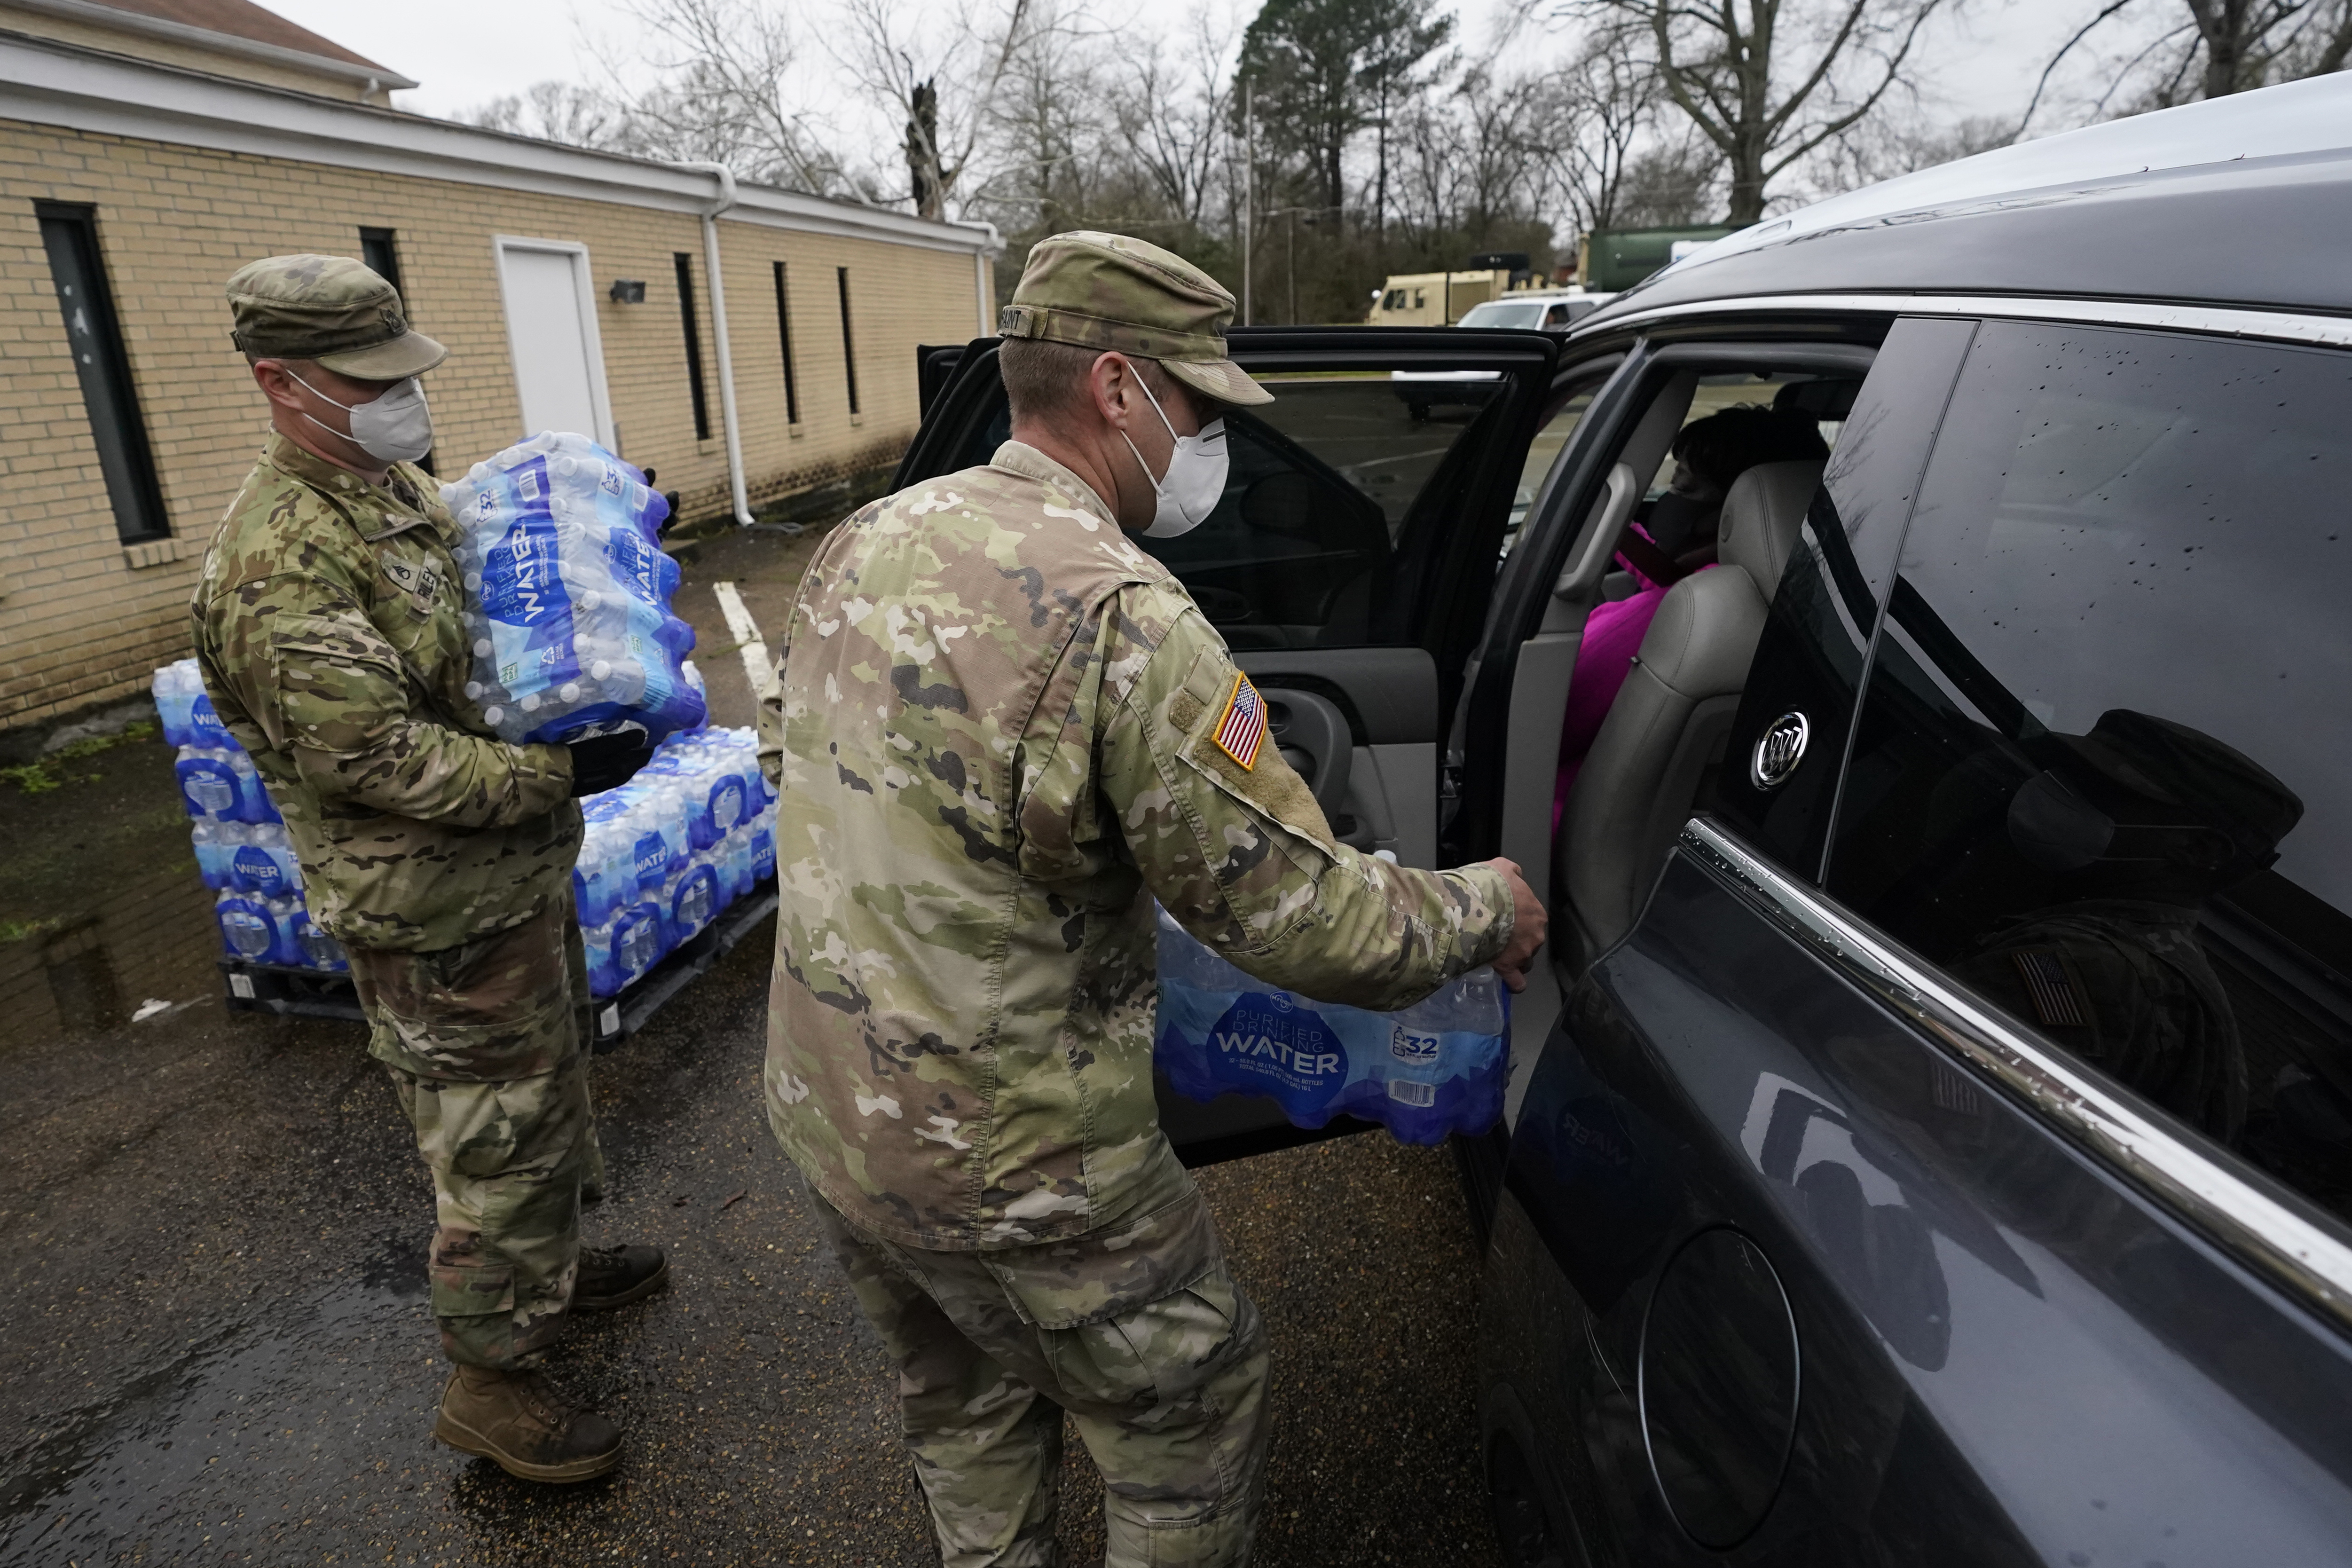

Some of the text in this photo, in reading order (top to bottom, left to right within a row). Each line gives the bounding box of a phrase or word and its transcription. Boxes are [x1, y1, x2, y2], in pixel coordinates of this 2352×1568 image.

[494, 550, 514, 617] PURIFIED
[502, 544, 524, 616] DRINKING
[511, 524, 544, 623] WATER
[1272, 994, 1292, 1009] Kroger
[1233, 1021, 1324, 1052] DRINKING
[1236, 1010, 1322, 1042] PURIFIED
[1216, 1032, 1339, 1075] WATER
[1406, 1035, 1438, 1055] 32
